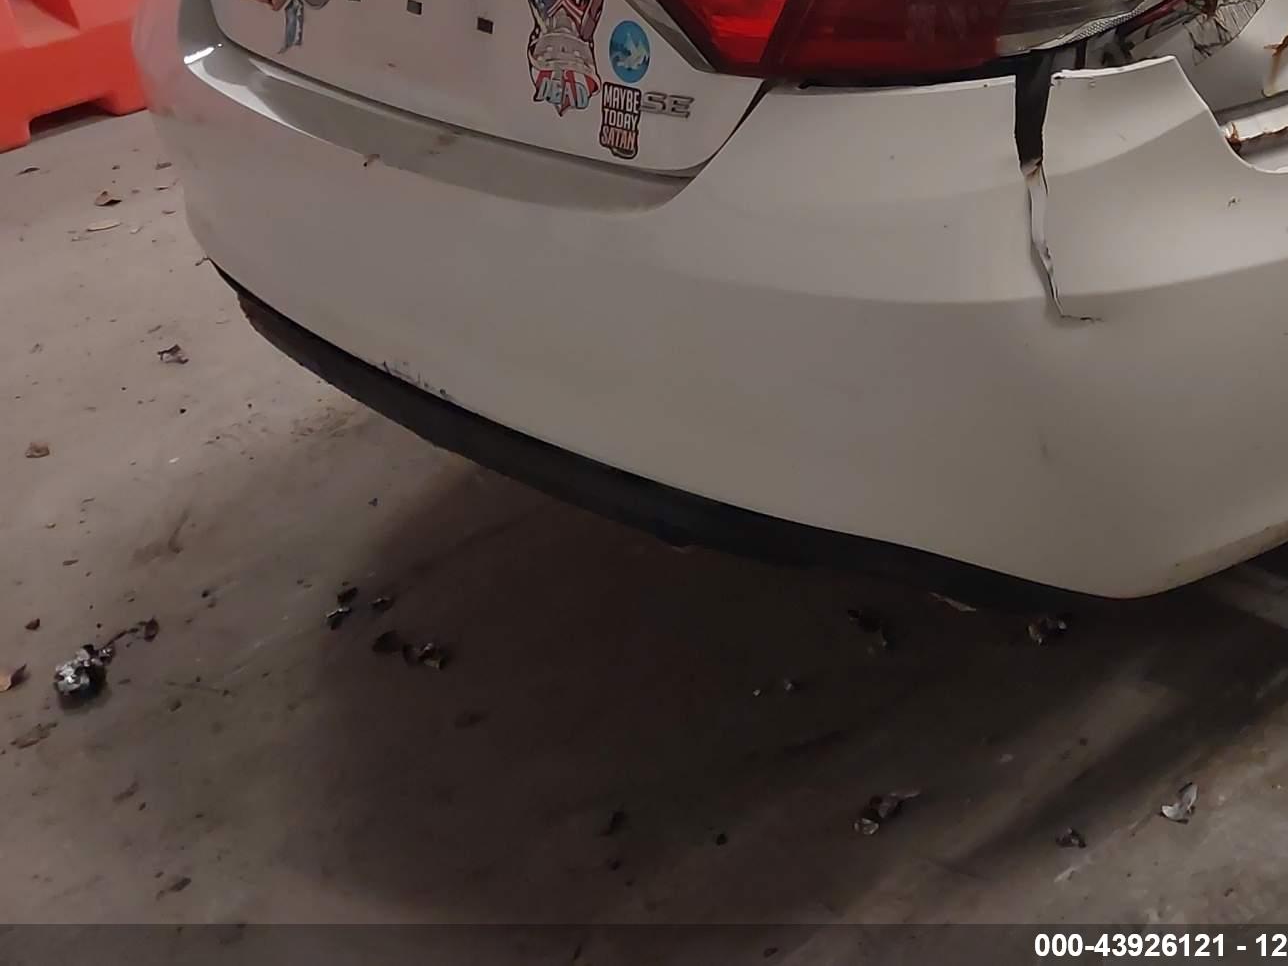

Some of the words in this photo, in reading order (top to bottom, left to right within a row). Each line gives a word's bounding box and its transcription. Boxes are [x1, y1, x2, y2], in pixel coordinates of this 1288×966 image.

[603, 84, 641, 115] MAYBE
[639, 91, 695, 118] SE
[602, 107, 639, 131] TODAY
[601, 125, 637, 150] SATAN
